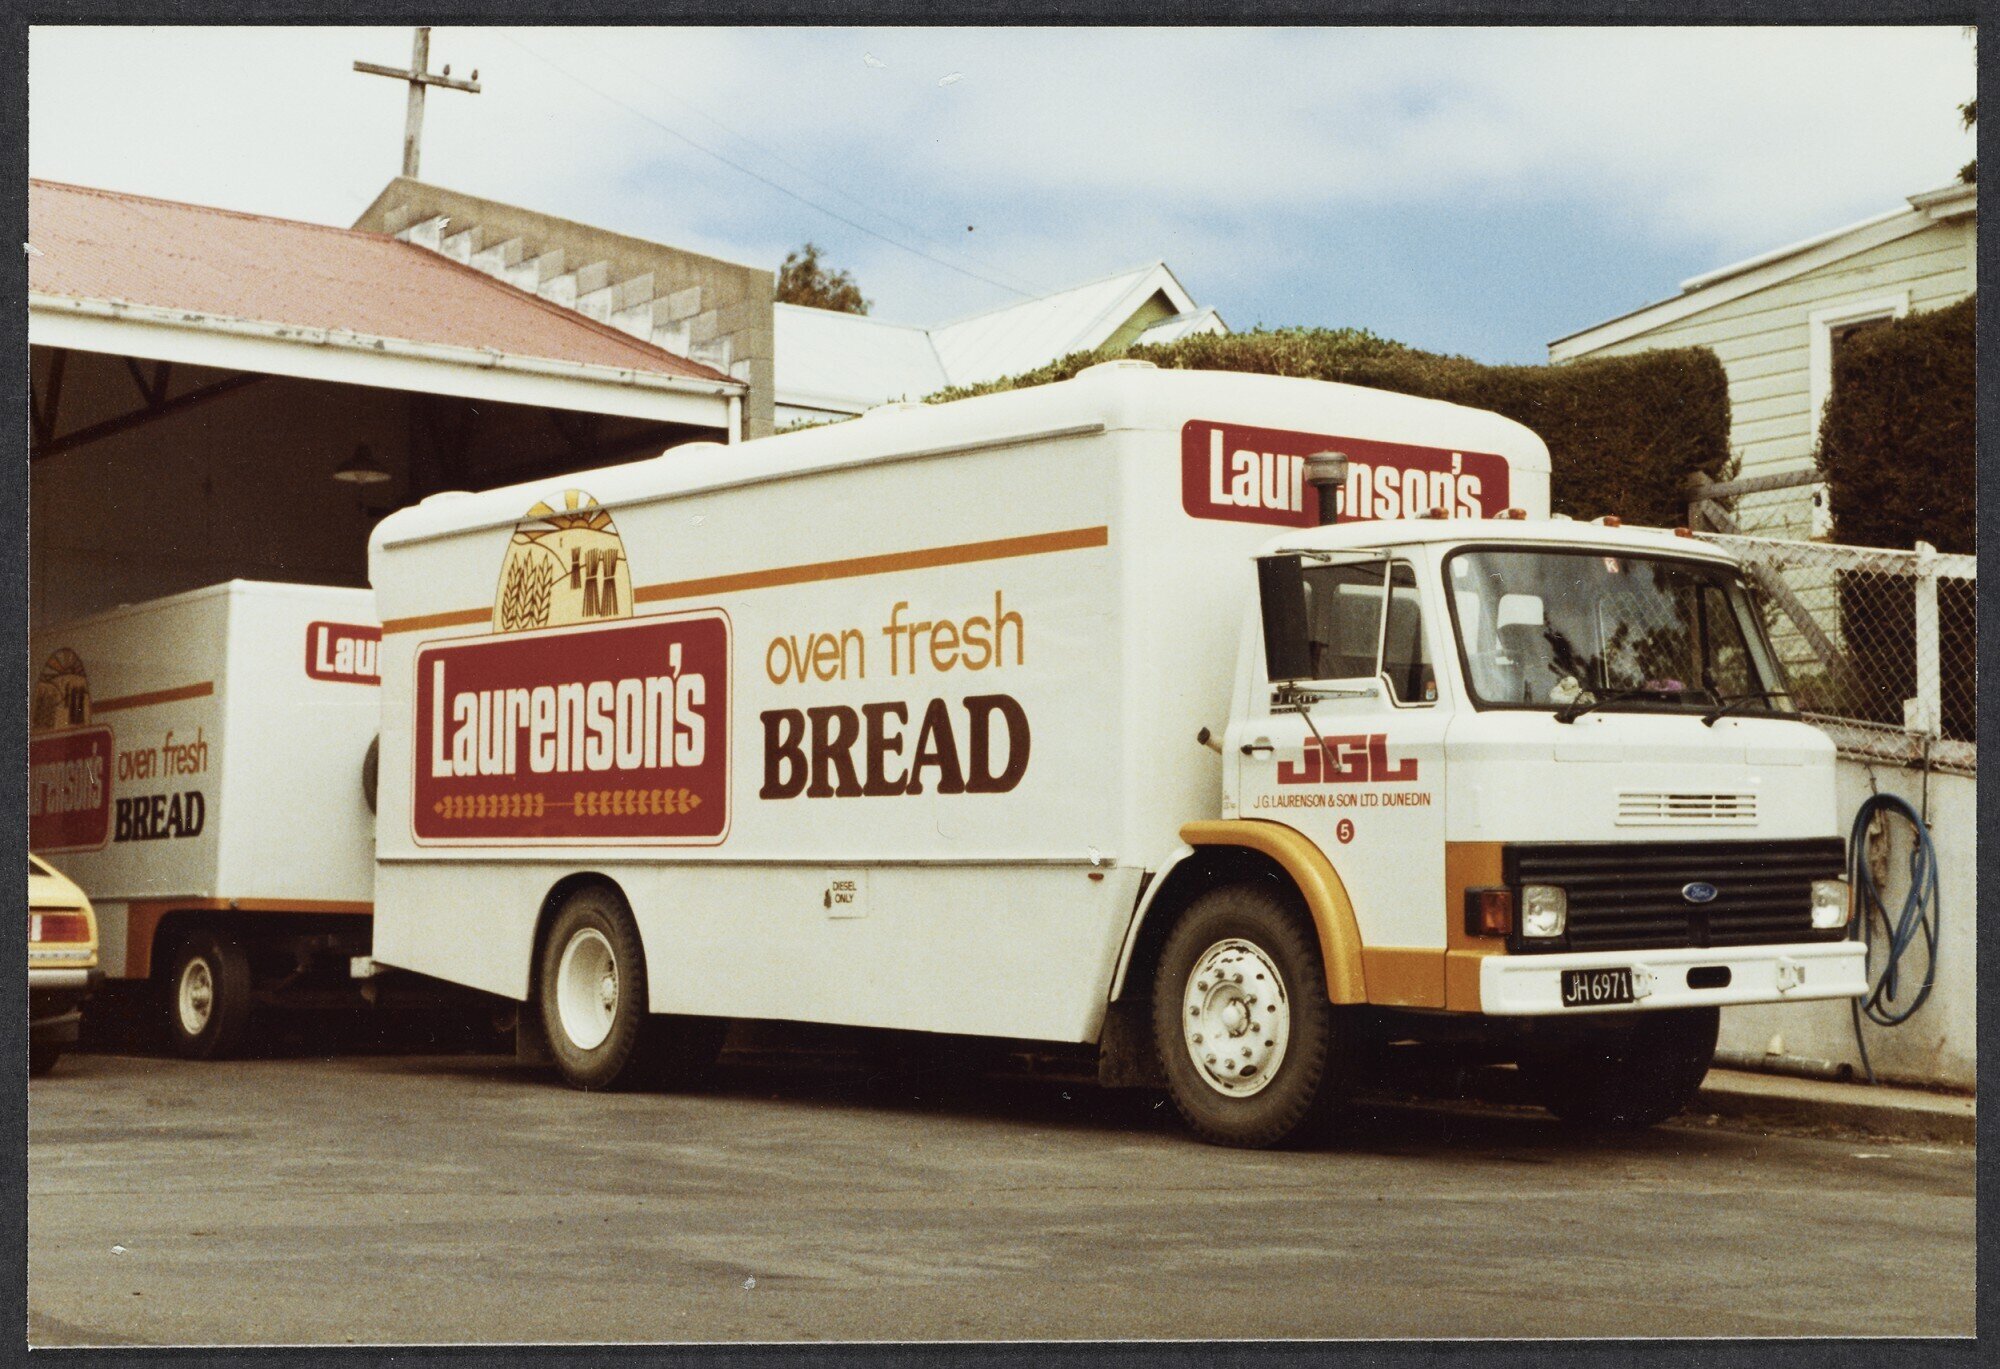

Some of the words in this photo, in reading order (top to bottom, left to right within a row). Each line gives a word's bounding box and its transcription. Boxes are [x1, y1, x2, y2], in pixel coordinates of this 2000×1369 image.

[1210, 429, 1481, 520] Laurnson's
[766, 629, 865, 685] oven
[882, 590, 1024, 676] fresh
[432, 643, 705, 778] Laurenson's
[117, 748, 157, 782] oven
[162, 726, 208, 777] fresh
[759, 693, 1031, 800] BREAD
[1277, 733, 1418, 784] JGL
[113, 791, 205, 843] BREAD
[1327, 795, 1335, 807] &
[1336, 794, 1357, 807] SON
[1382, 792, 1431, 806] DUNEDIN
[1340, 823, 1350, 840] 5
[832, 881, 857, 891] DIESEL
[835, 893, 854, 903] ONLY
